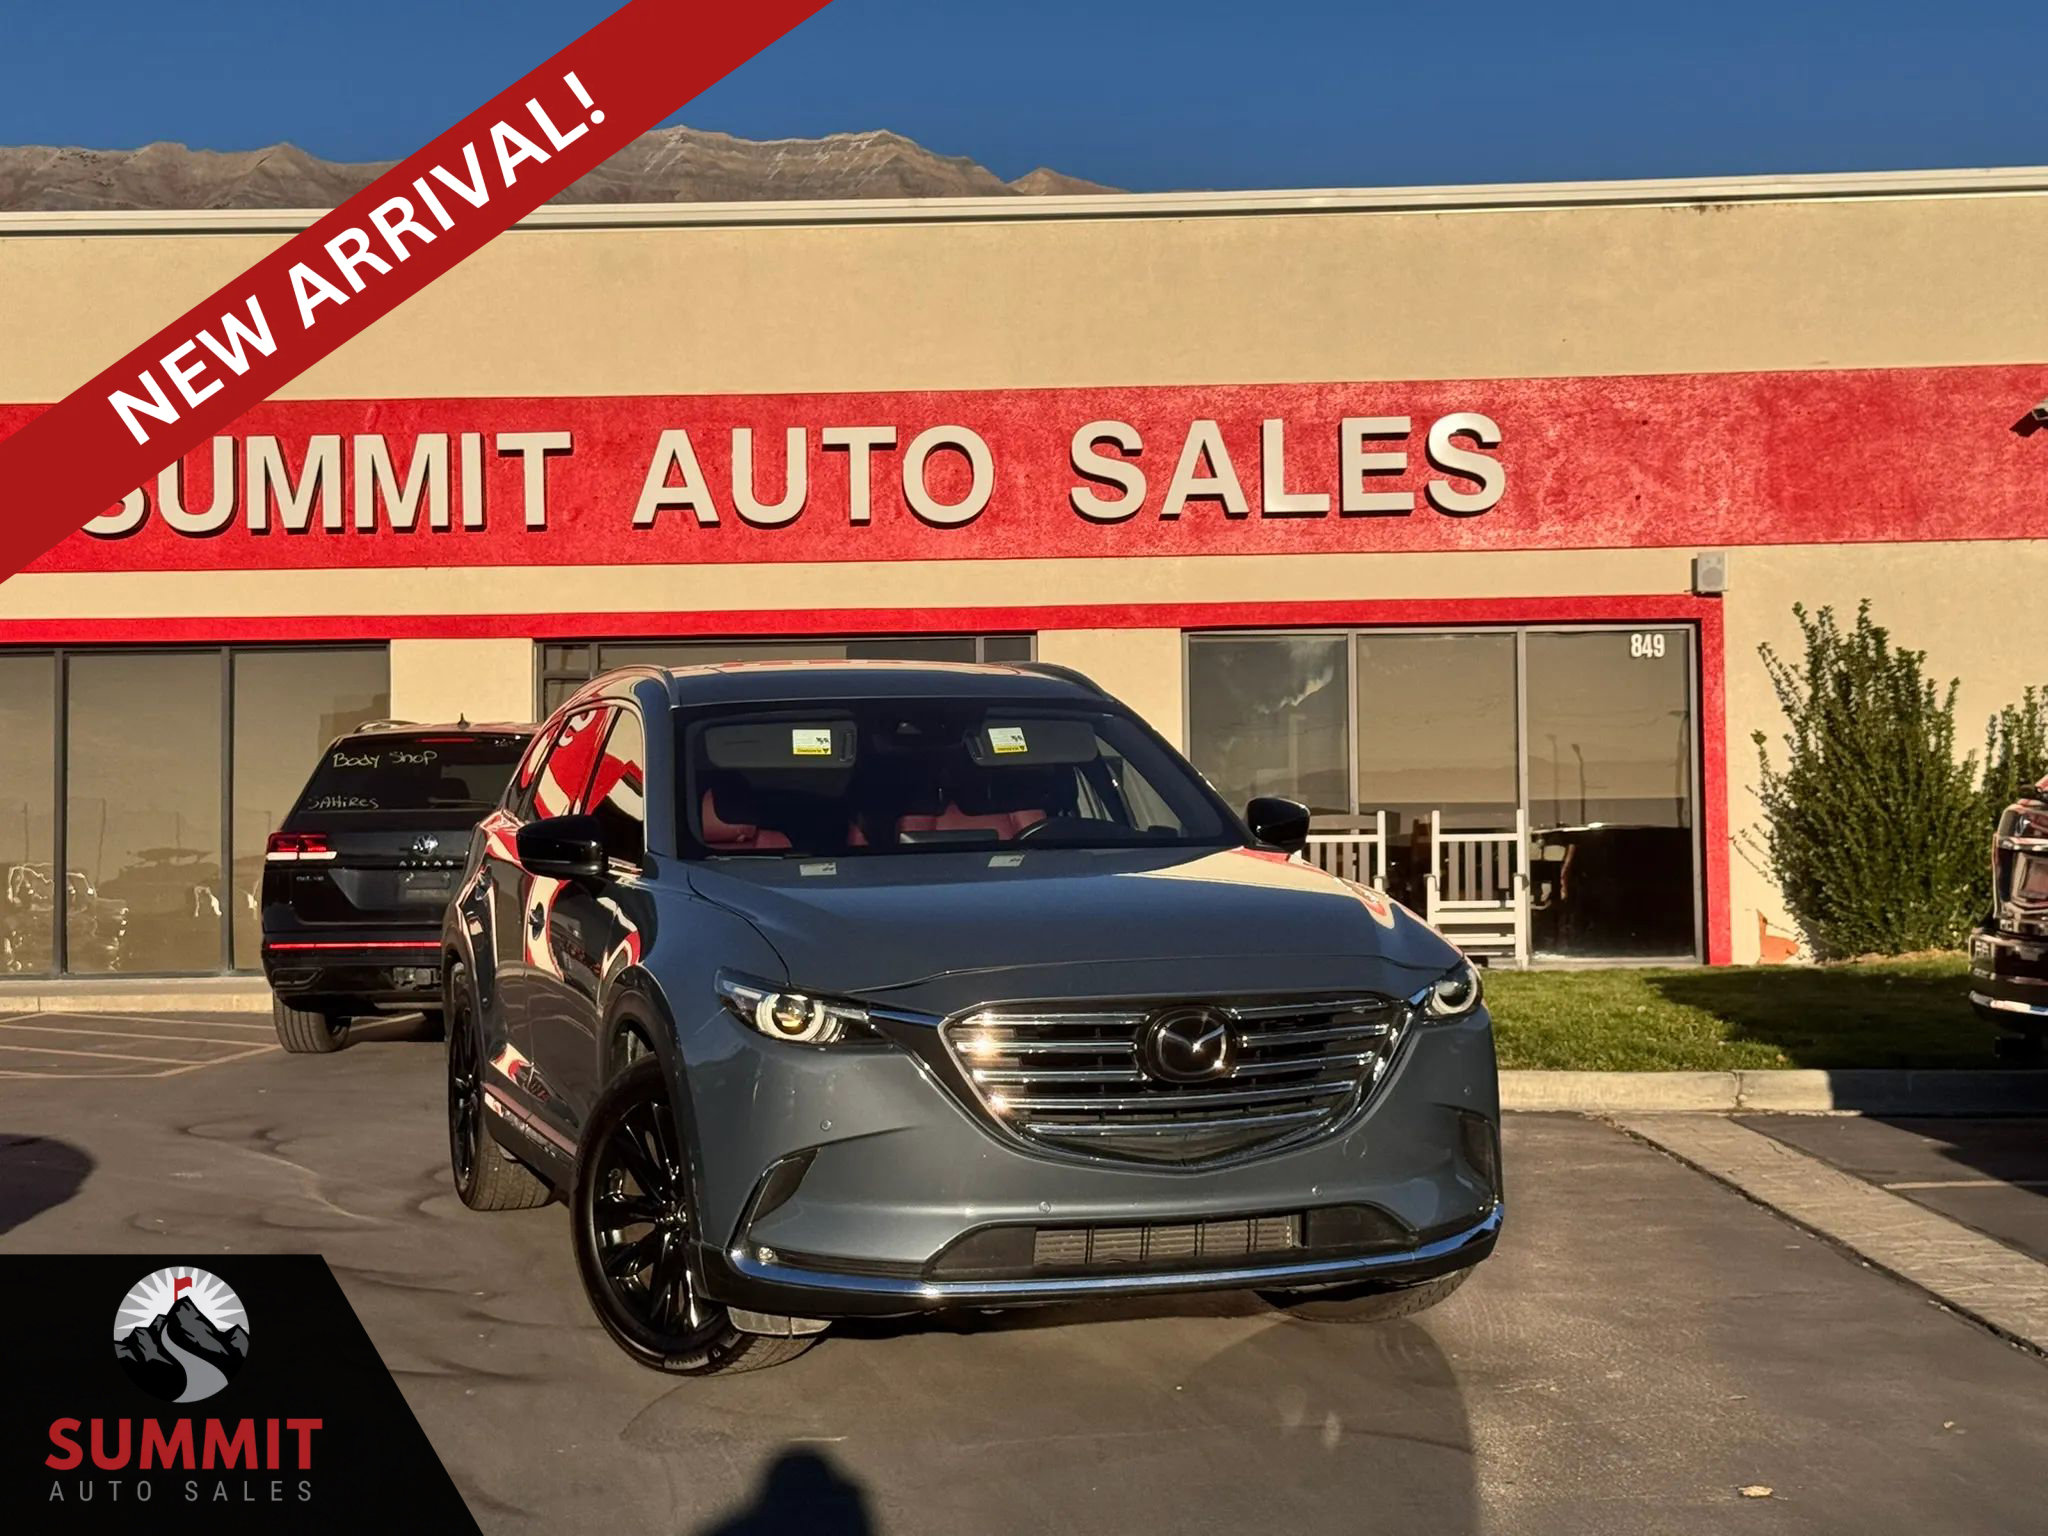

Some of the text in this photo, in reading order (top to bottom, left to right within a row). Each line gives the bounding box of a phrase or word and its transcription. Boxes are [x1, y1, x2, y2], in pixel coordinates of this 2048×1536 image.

[632, 424, 997, 528] AUTO
[1070, 411, 1508, 519] SALES
[1631, 633, 1665, 658] 849
